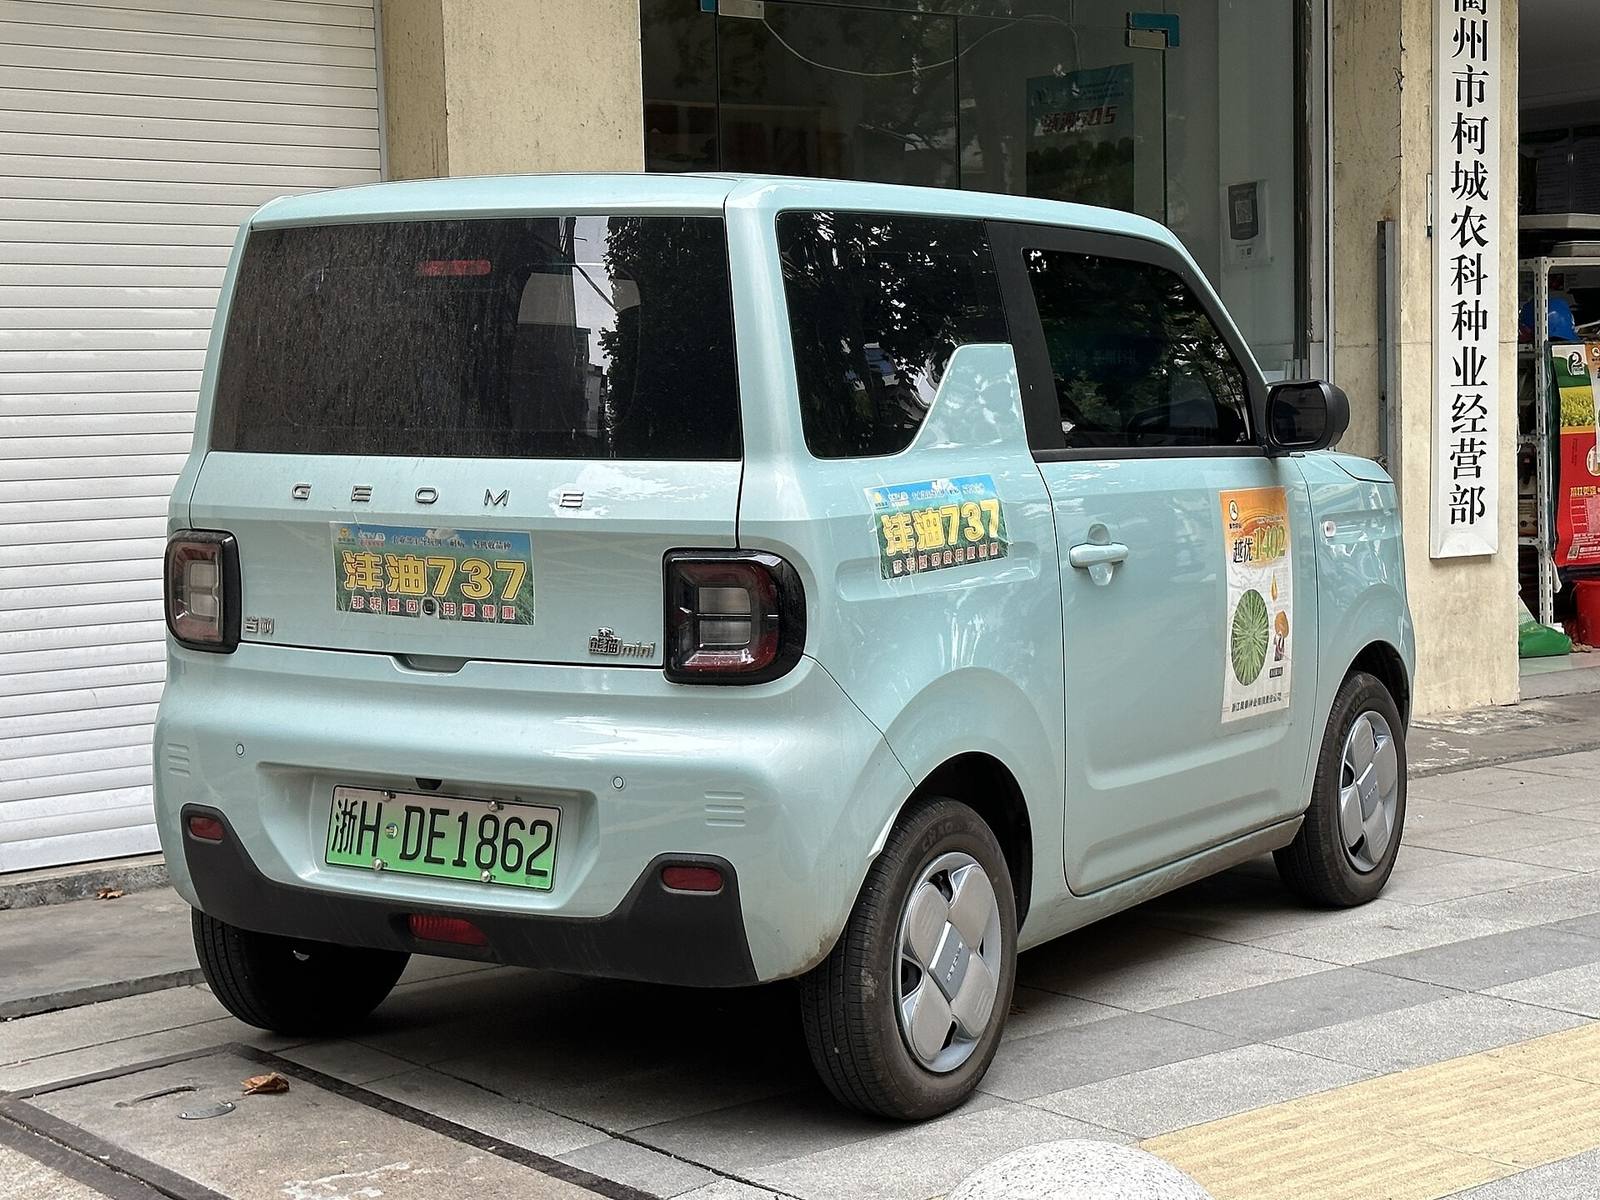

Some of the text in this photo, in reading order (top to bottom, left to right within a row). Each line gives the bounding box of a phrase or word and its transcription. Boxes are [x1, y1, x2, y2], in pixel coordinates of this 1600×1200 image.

[291, 482, 586, 508] GEOME
[881, 498, 1000, 556] 沣油737
[342, 551, 527, 601] 沣油737
[352, 596, 516, 619] 非转基因用更健康
[331, 797, 554, 878] 浙H DE1862
